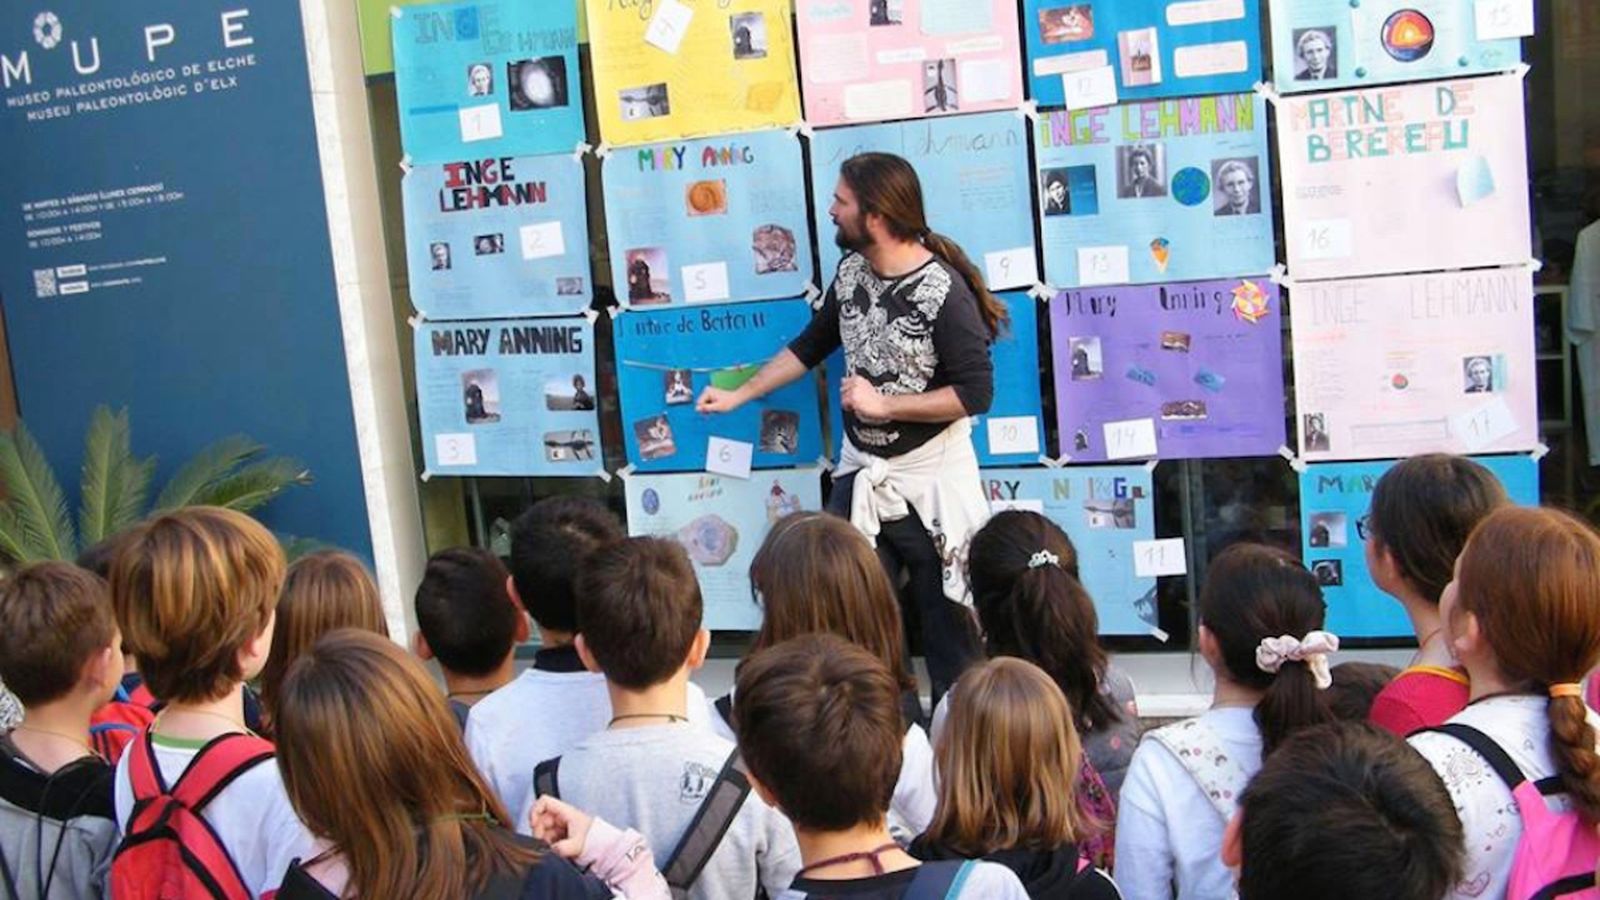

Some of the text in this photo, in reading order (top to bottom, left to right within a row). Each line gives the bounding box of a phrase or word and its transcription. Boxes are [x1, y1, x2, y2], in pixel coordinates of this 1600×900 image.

[7, 54, 256, 107] MUSEO PALEONTOLÓGICO DE ELCHE
[27, 105, 71, 121] MUSEU
[1437, 83, 1475, 117] DE
[1122, 95, 1254, 141] LEHMANN
[443, 157, 515, 189] INGE
[440, 181, 547, 213] LEHMANN
[999, 256, 1010, 279] 9
[1410, 275, 1519, 321] LEHMANN
[431, 326, 583, 357] MARY ANNING
[445, 438, 460, 461] 3
[719, 443, 732, 463] 6
